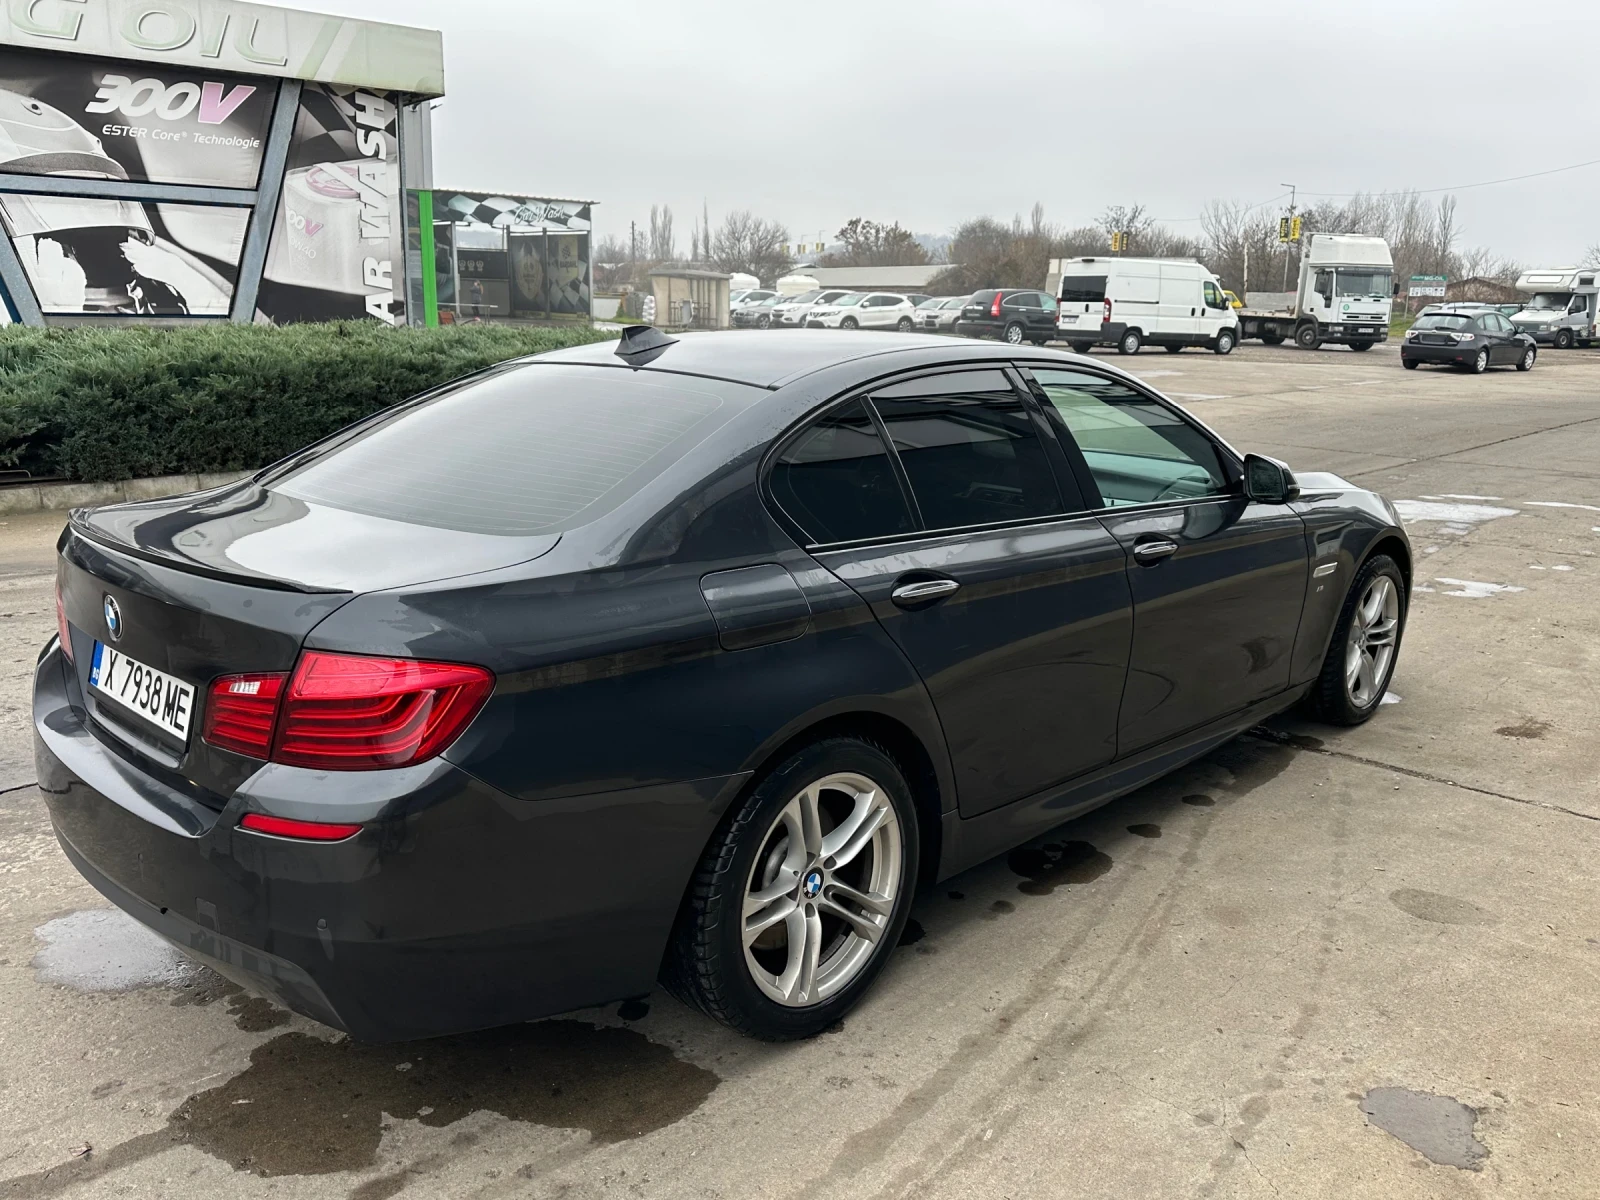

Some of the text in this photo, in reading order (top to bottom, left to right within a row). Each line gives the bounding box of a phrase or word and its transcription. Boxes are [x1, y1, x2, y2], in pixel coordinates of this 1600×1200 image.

[84, 74, 257, 125] 300V
[102, 124, 148, 139] ESTER
[193, 132, 261, 150] Technologie
[354, 91, 391, 240] WASH
[285, 204, 324, 238] 00V
[514, 204, 566, 225] Car Wash
[120, 658, 163, 716] 7938
[161, 680, 190, 733] ME
